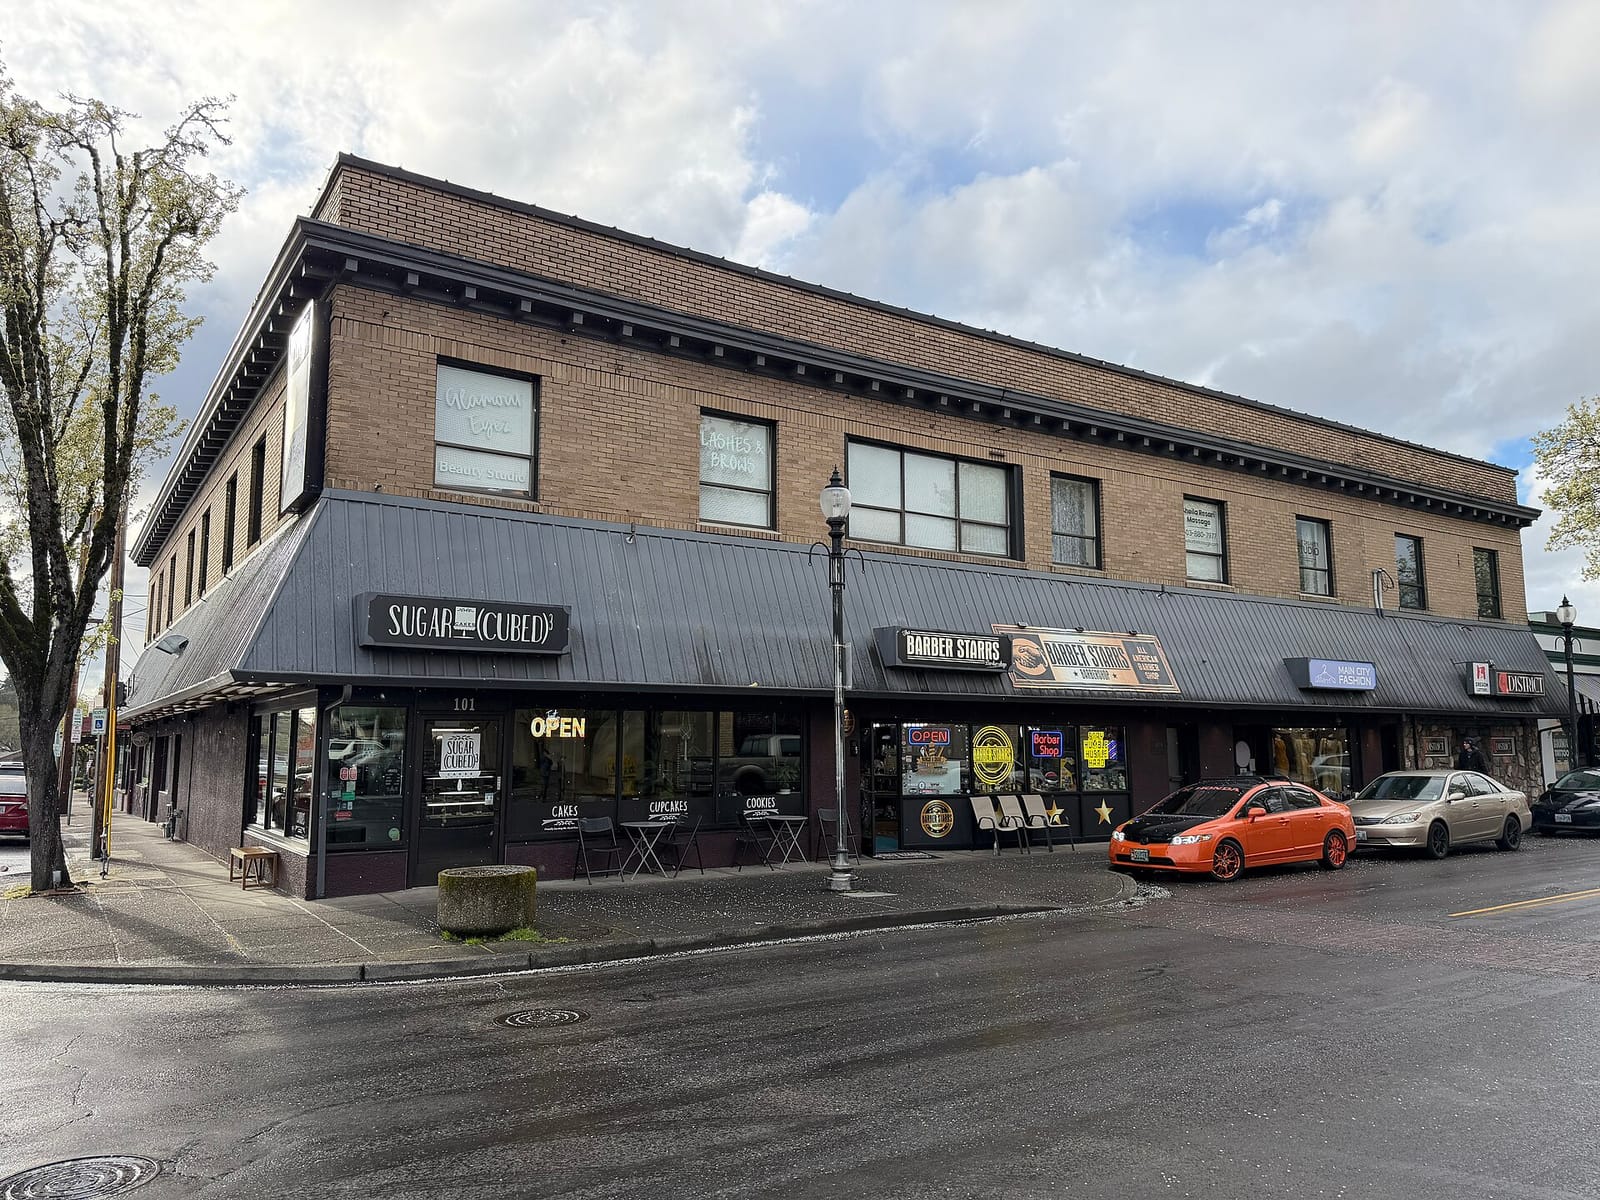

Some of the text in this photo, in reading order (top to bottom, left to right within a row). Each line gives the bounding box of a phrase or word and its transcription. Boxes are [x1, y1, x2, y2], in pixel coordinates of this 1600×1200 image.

[701, 430, 764, 455] LASHES &
[711, 452, 755, 474] BROWS
[440, 461, 526, 483] Beauty Studio
[388, 604, 453, 638] SUGAR
[906, 635, 1000, 661] BARBER STARRS
[1044, 642, 1130, 669] BARBER STARRS
[1338, 666, 1371, 676] MAIN CITY
[1339, 675, 1372, 686] FASHION
[1508, 675, 1543, 693] DISTRICT
[453, 698, 476, 711] 101
[531, 717, 585, 738] OPEN
[911, 731, 948, 742] OPEN
[1033, 733, 1060, 744] Barber
[447, 740, 475, 754] SUGAR
[1040, 745, 1060, 757] Shop
[650, 800, 688, 813] CUPCAKES
[746, 797, 776, 809] COOKIES
[552, 805, 578, 818] CAKES
